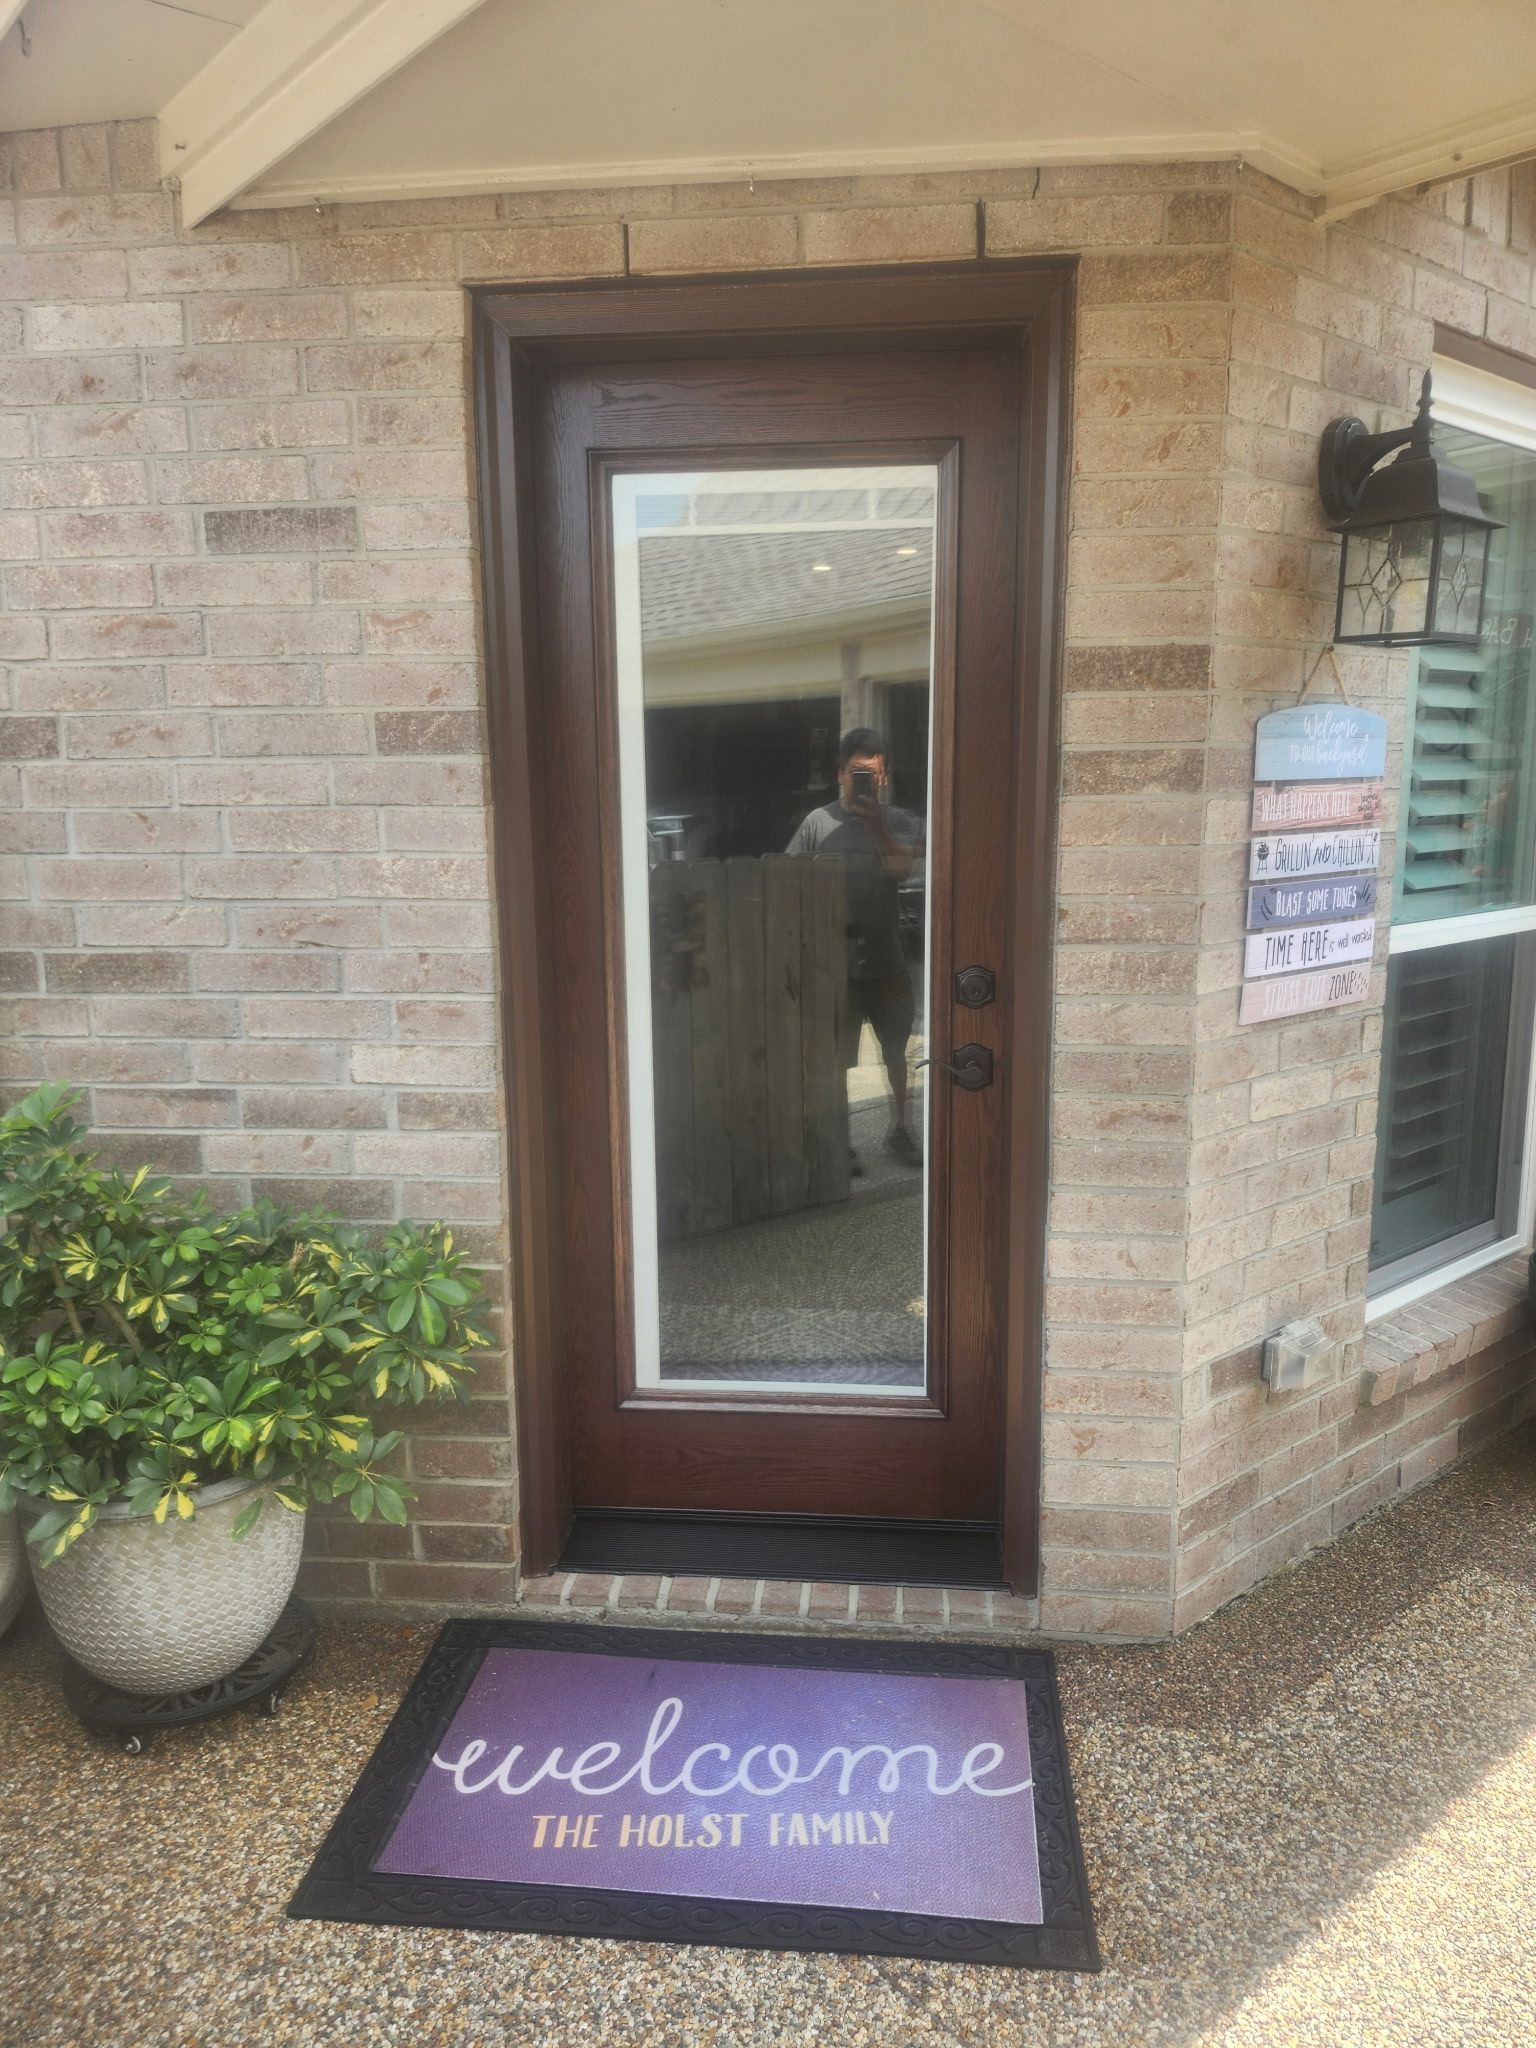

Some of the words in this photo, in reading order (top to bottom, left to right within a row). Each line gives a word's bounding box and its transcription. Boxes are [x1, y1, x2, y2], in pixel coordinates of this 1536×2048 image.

[1304, 711, 1358, 743] Welcome
[1262, 792, 1289, 821] WHAT
[1290, 792, 1330, 820] HAPPENS
[1331, 791, 1352, 817] HERE
[1275, 890, 1305, 918] BLAST
[1307, 890, 1328, 915] SOME
[1333, 886, 1356, 911] TUNES
[1264, 934, 1295, 970] TIME
[1300, 929, 1329, 967] HERE
[1328, 970, 1355, 1001] ZONE
[431, 1696, 1036, 1798] welcome
[531, 1813, 600, 1850] THE
[618, 1812, 750, 1850] HOLST
[769, 1809, 895, 1848] FAMILY
